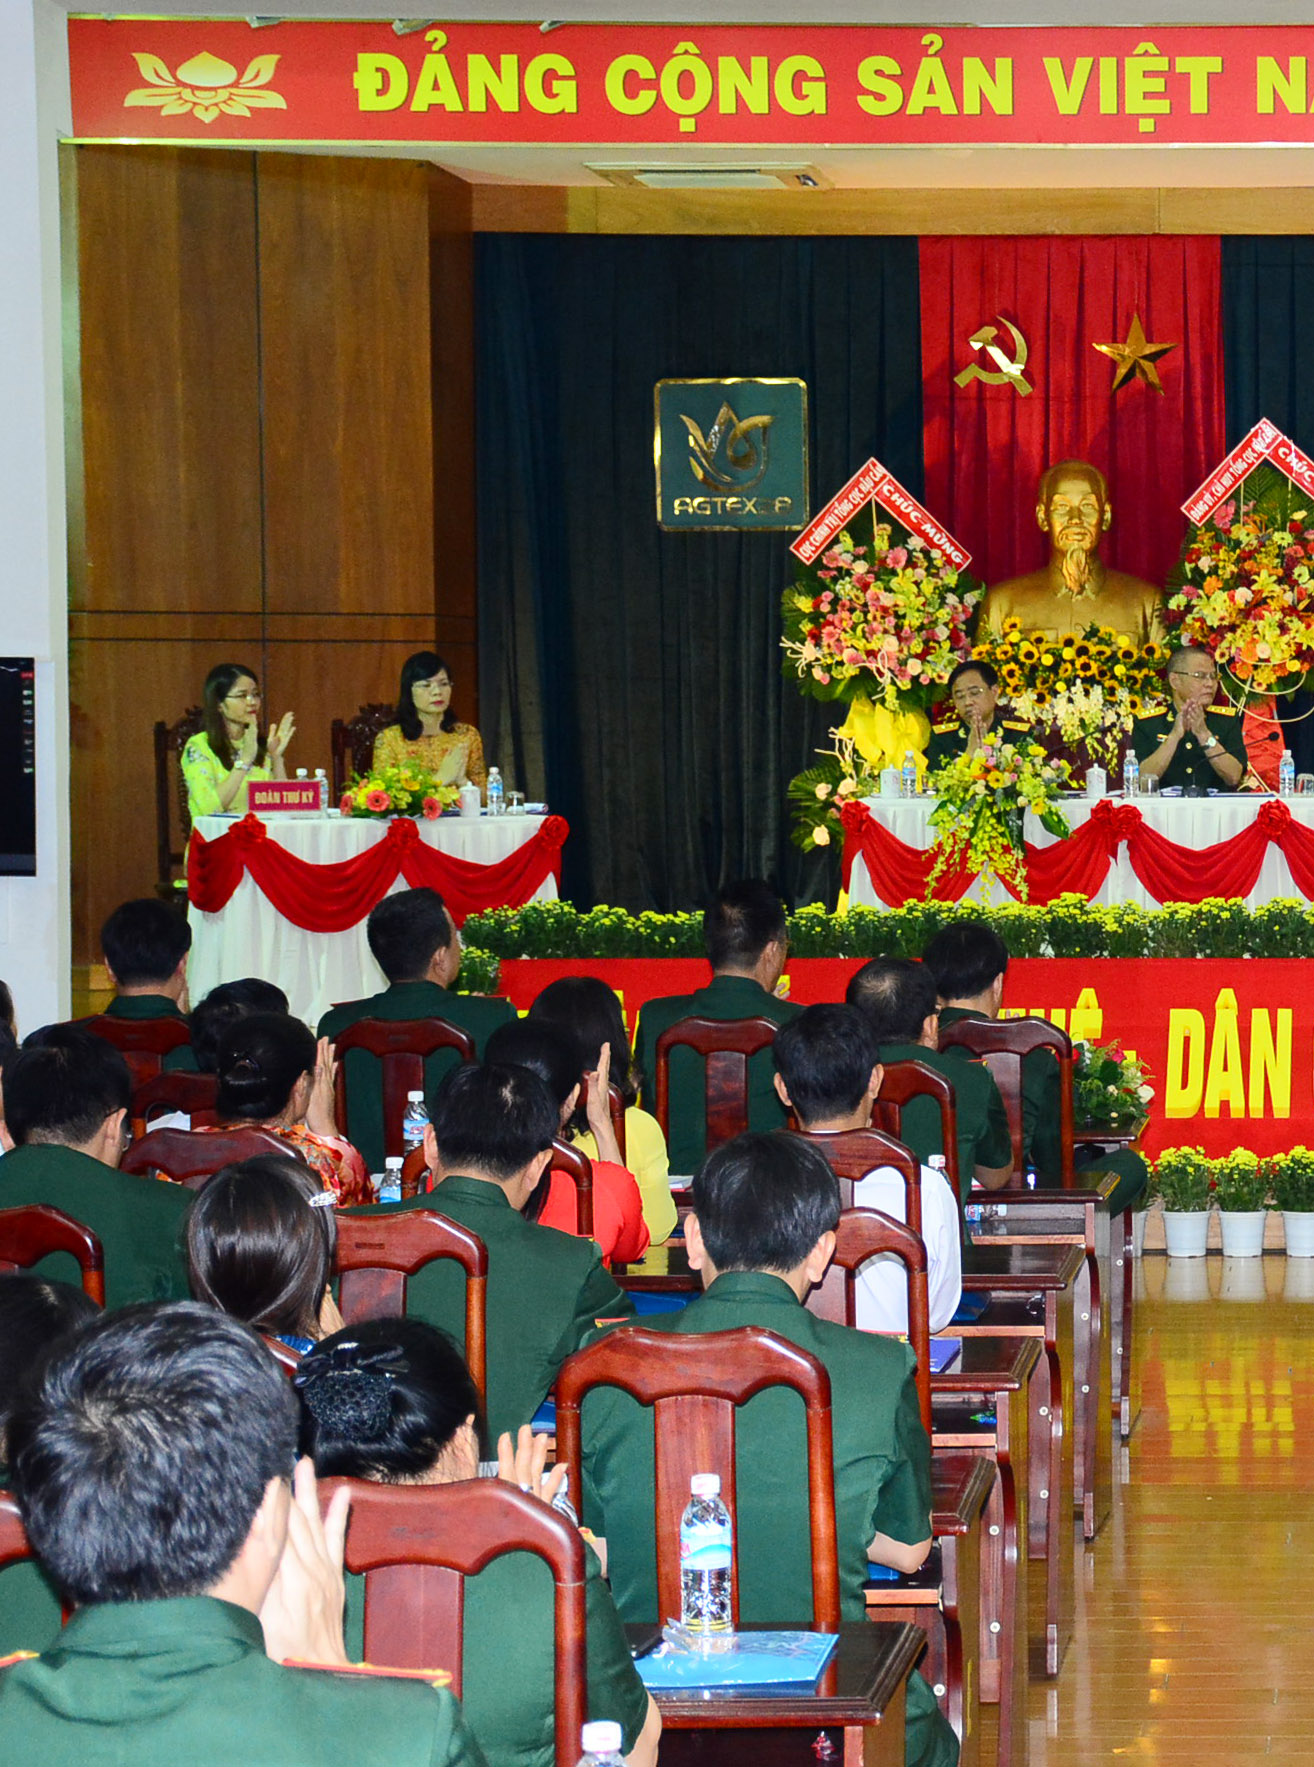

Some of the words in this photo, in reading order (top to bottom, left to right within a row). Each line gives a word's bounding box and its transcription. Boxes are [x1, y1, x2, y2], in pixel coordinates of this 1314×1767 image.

[354, 29, 577, 114] ĐẢNG
[605, 42, 827, 132] CỘNG
[857, 29, 1012, 115] SẢN
[1043, 42, 1222, 133] VIỆT
[1278, 447, 1314, 482] CHÚC
[882, 484, 922, 523] CHÚC
[920, 523, 963, 563] MỪNG
[1165, 988, 1293, 1118] DÂN
